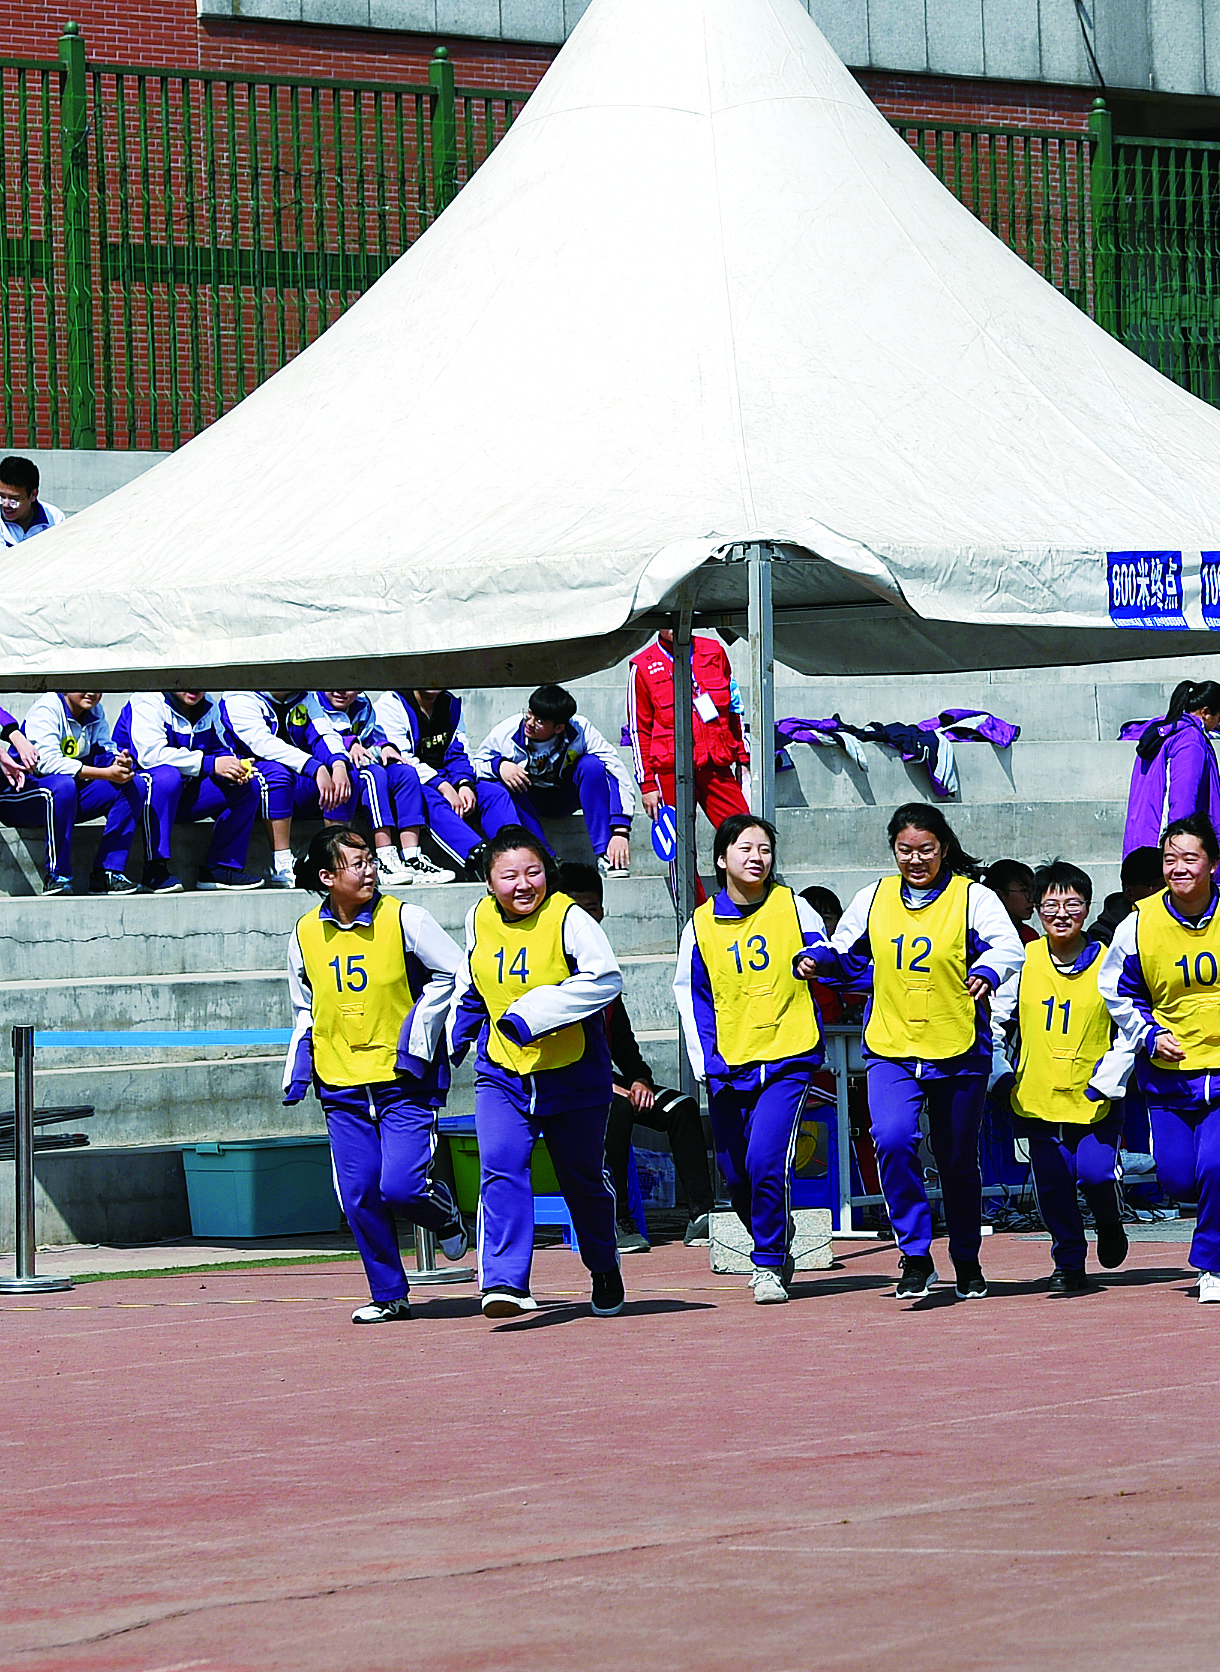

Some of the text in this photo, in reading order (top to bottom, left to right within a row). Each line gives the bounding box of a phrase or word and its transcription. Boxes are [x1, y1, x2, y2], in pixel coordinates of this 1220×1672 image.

[1112, 558, 1178, 611] 800米终点
[64, 739, 75, 755] 6
[494, 947, 531, 983] 14
[727, 935, 769, 974] 13
[891, 934, 931, 973] 12
[1175, 952, 1218, 988] 10
[329, 955, 367, 992] 15
[1042, 996, 1070, 1034] 11
